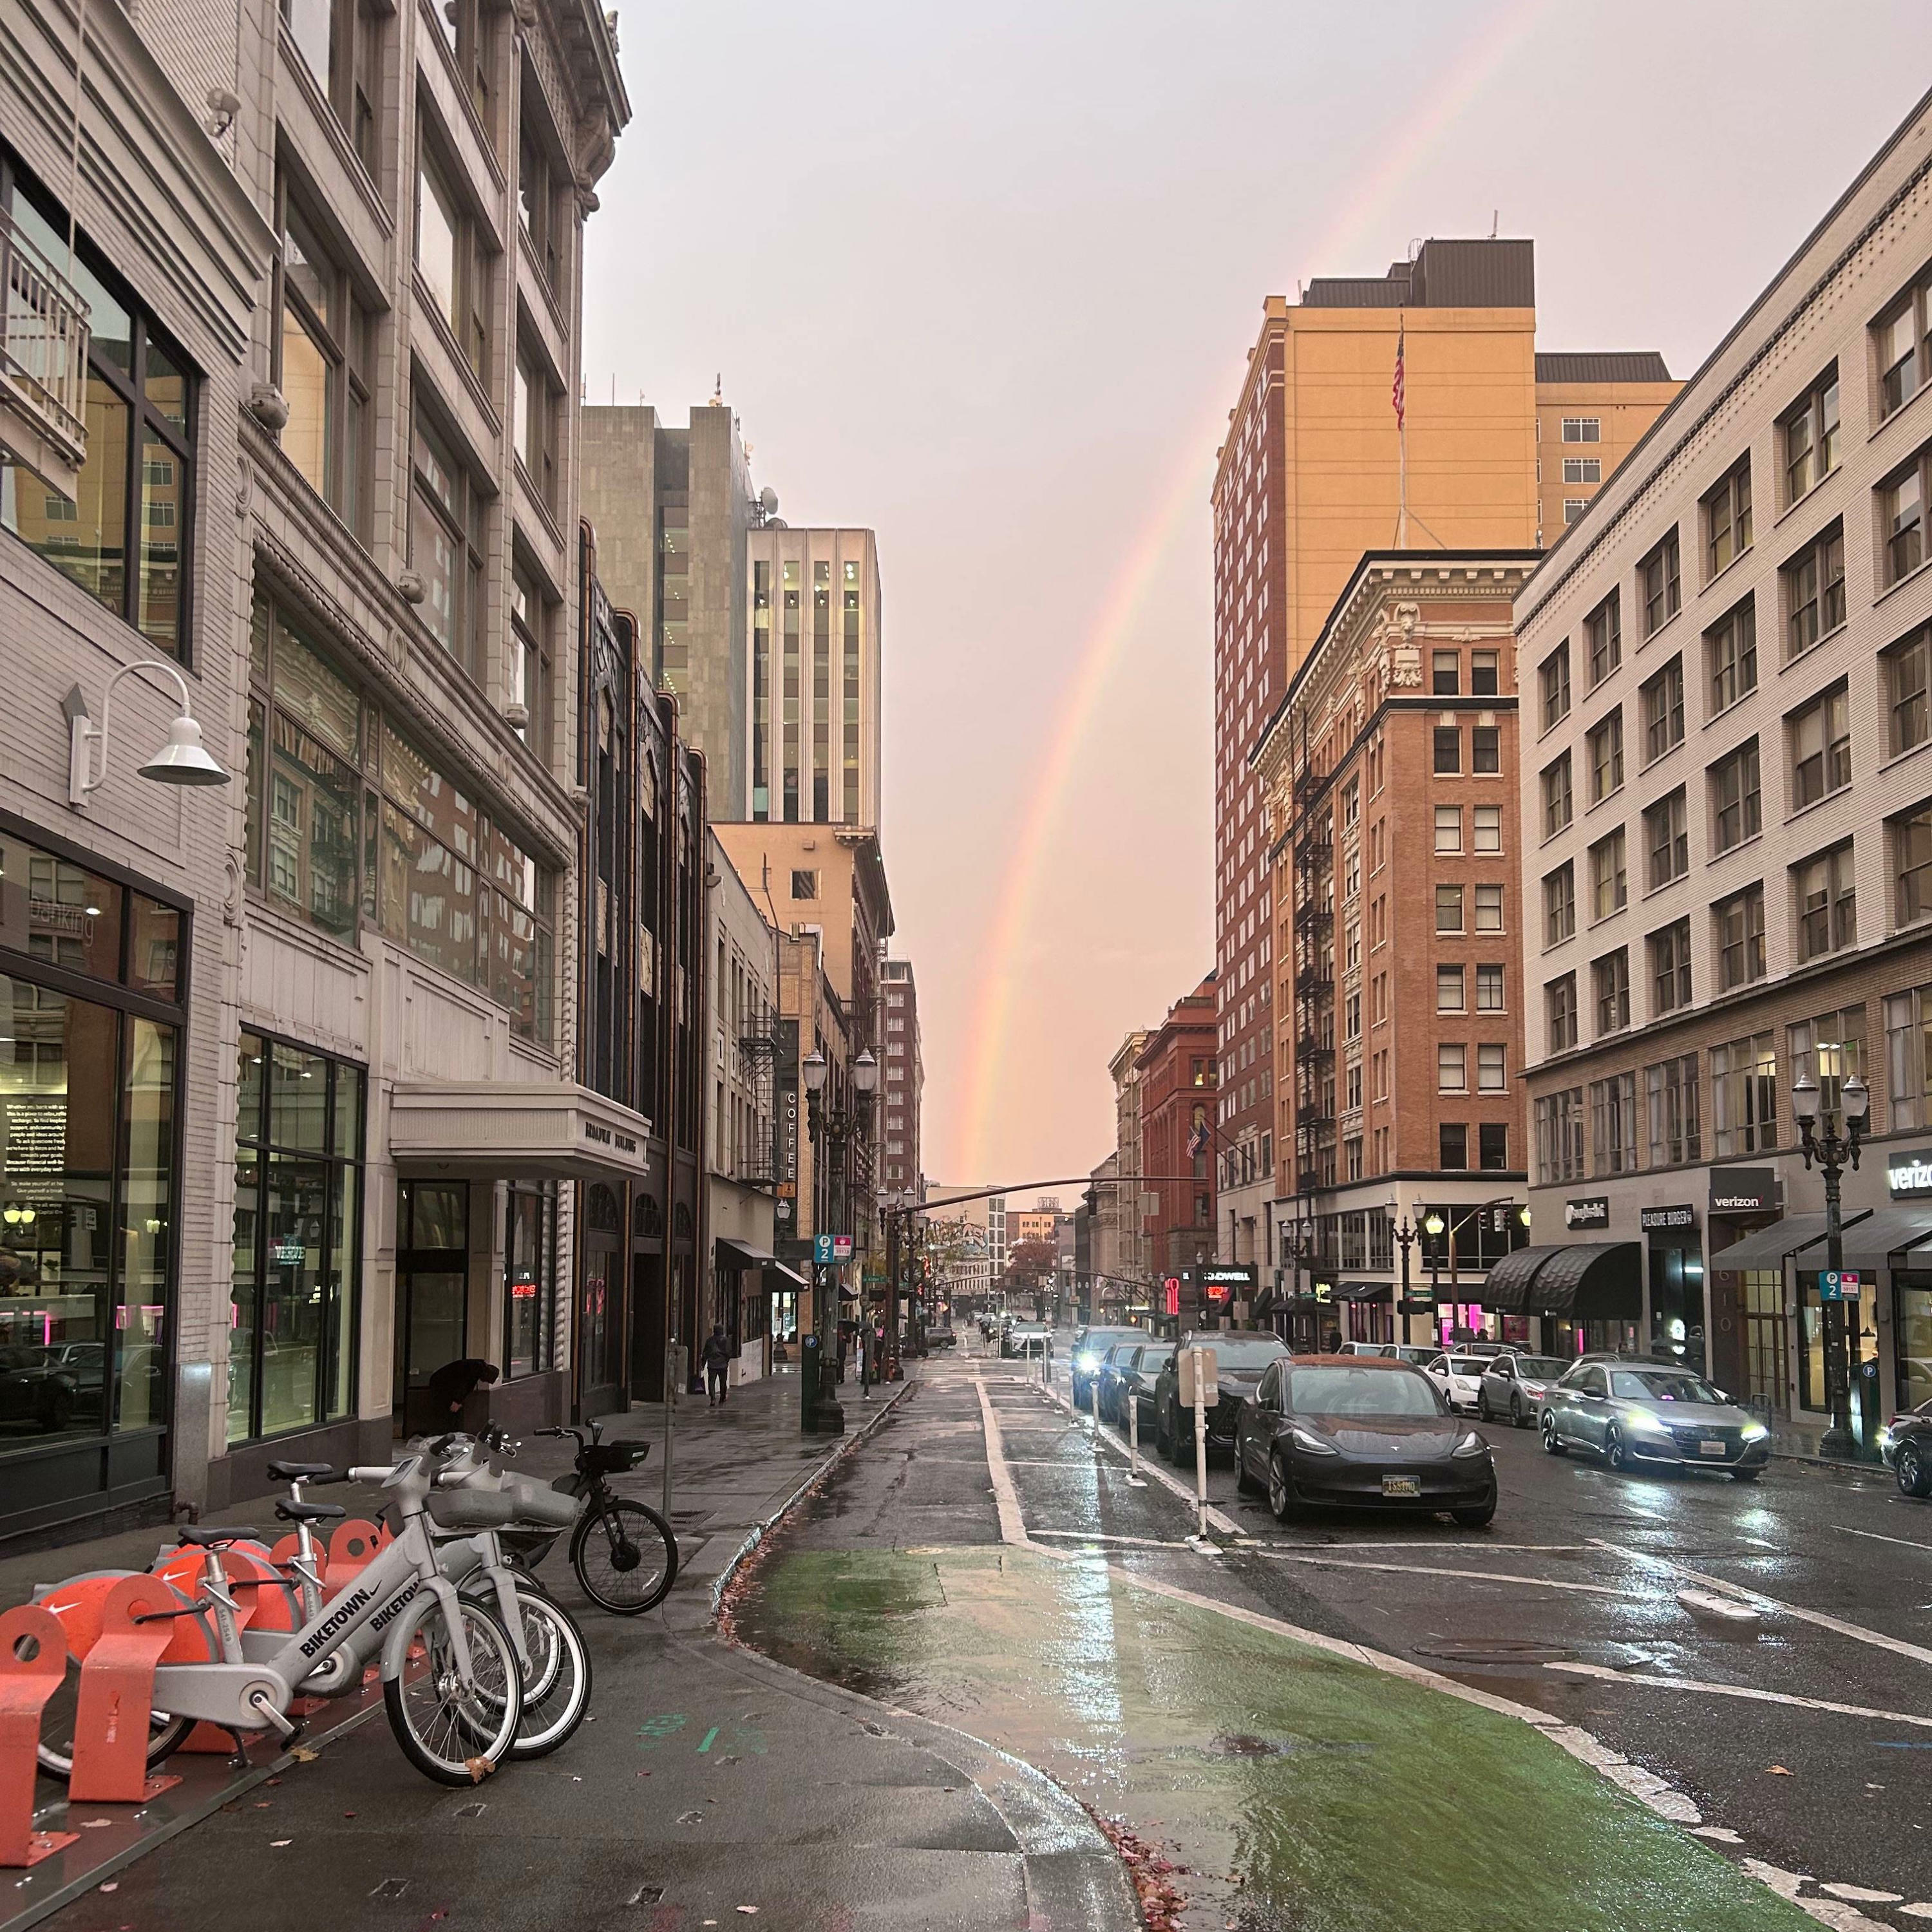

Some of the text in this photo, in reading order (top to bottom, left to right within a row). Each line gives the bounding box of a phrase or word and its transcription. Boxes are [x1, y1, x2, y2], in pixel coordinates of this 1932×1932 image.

[787, 1093, 796, 1179] COFFEE
[1714, 1196, 1759, 1207] verizon
[1642, 1211, 1667, 1227] PLEASURE
[820, 1249, 829, 1259] 2
[1828, 1285, 1837, 1296] 2
[299, 1588, 371, 1658] BIKETOWN
